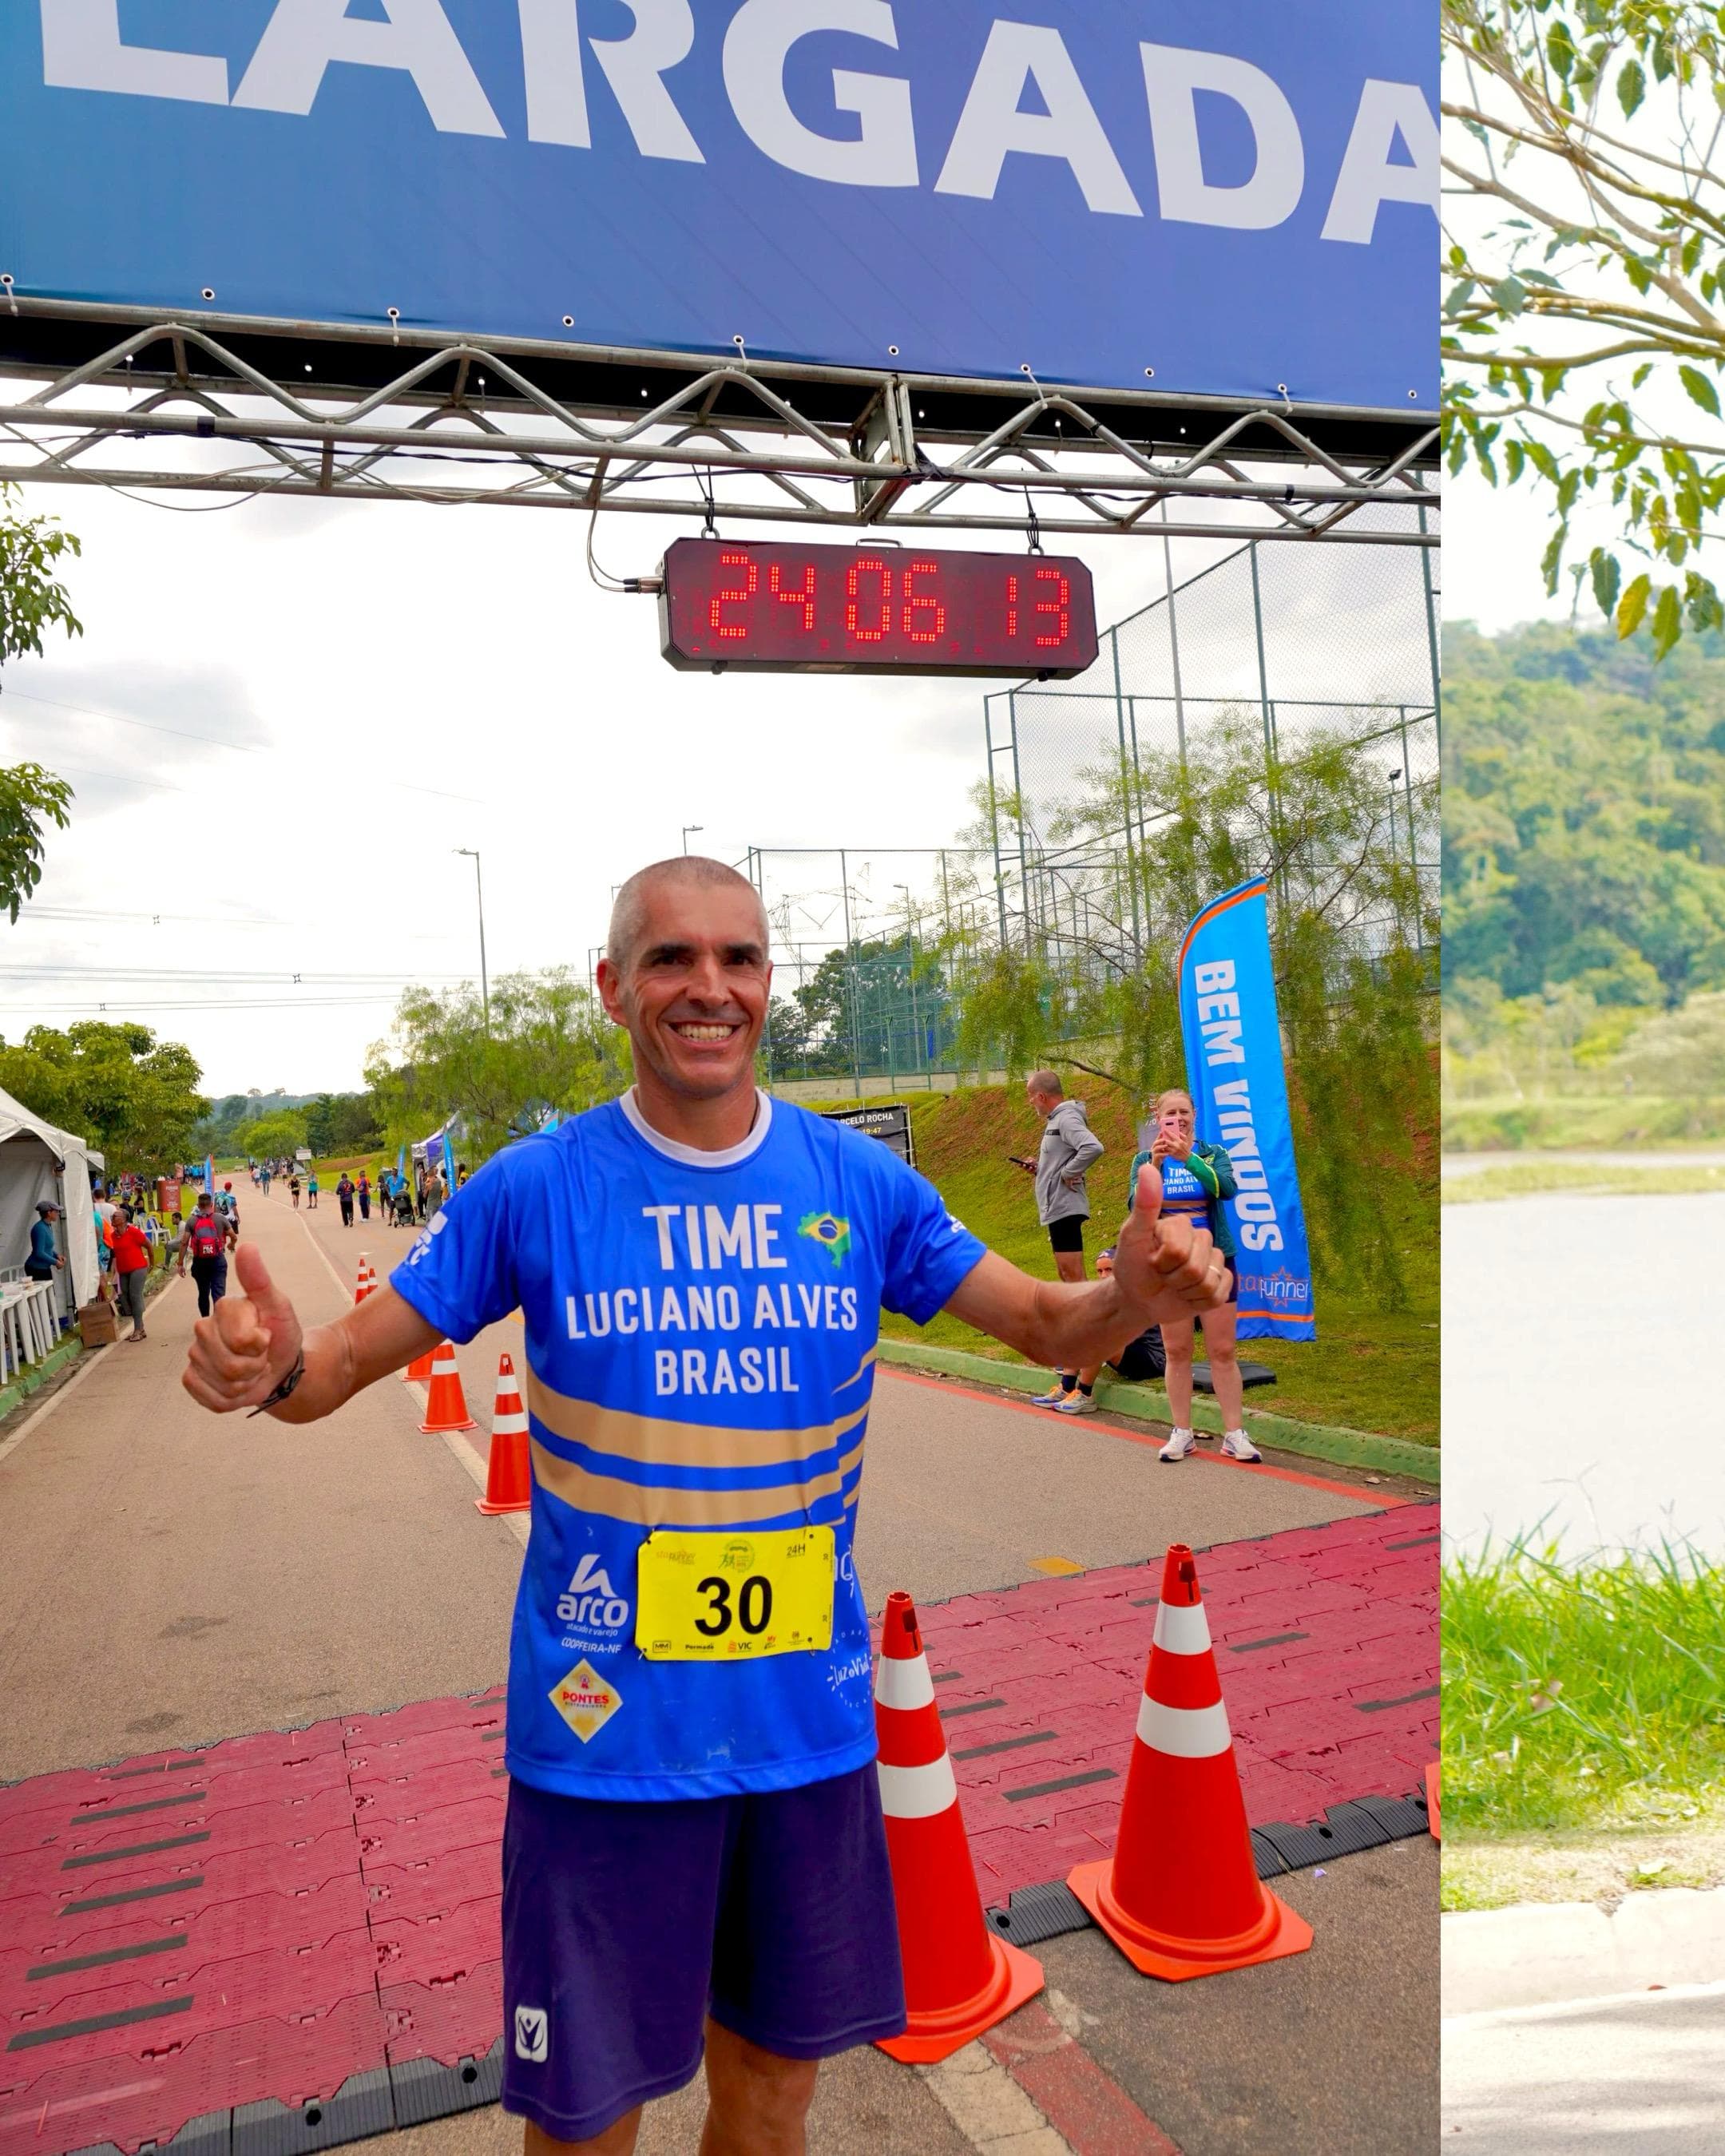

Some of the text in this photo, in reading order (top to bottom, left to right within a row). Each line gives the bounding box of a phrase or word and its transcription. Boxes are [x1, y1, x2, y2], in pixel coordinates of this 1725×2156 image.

[709, 554, 1069, 646] 24 06 13
[866, 1112, 894, 1123] ROCHA
[1194, 959, 1284, 1252] BEM VINDOS
[1167, 1184, 1196, 1195] BRASIL
[642, 1204, 787, 1270] TIME
[565, 1282, 858, 1340] LUCIANO ALVES
[655, 1346, 799, 1396] BRASIL
[556, 1592, 629, 1628] arco
[694, 1575, 773, 1637] 30
[561, 1638, 622, 1654] COOPFEIRA-NF
[593, 1627, 618, 1638] varejo
[737, 1642, 753, 1651] VIC
[562, 1691, 609, 1704] PONTES
